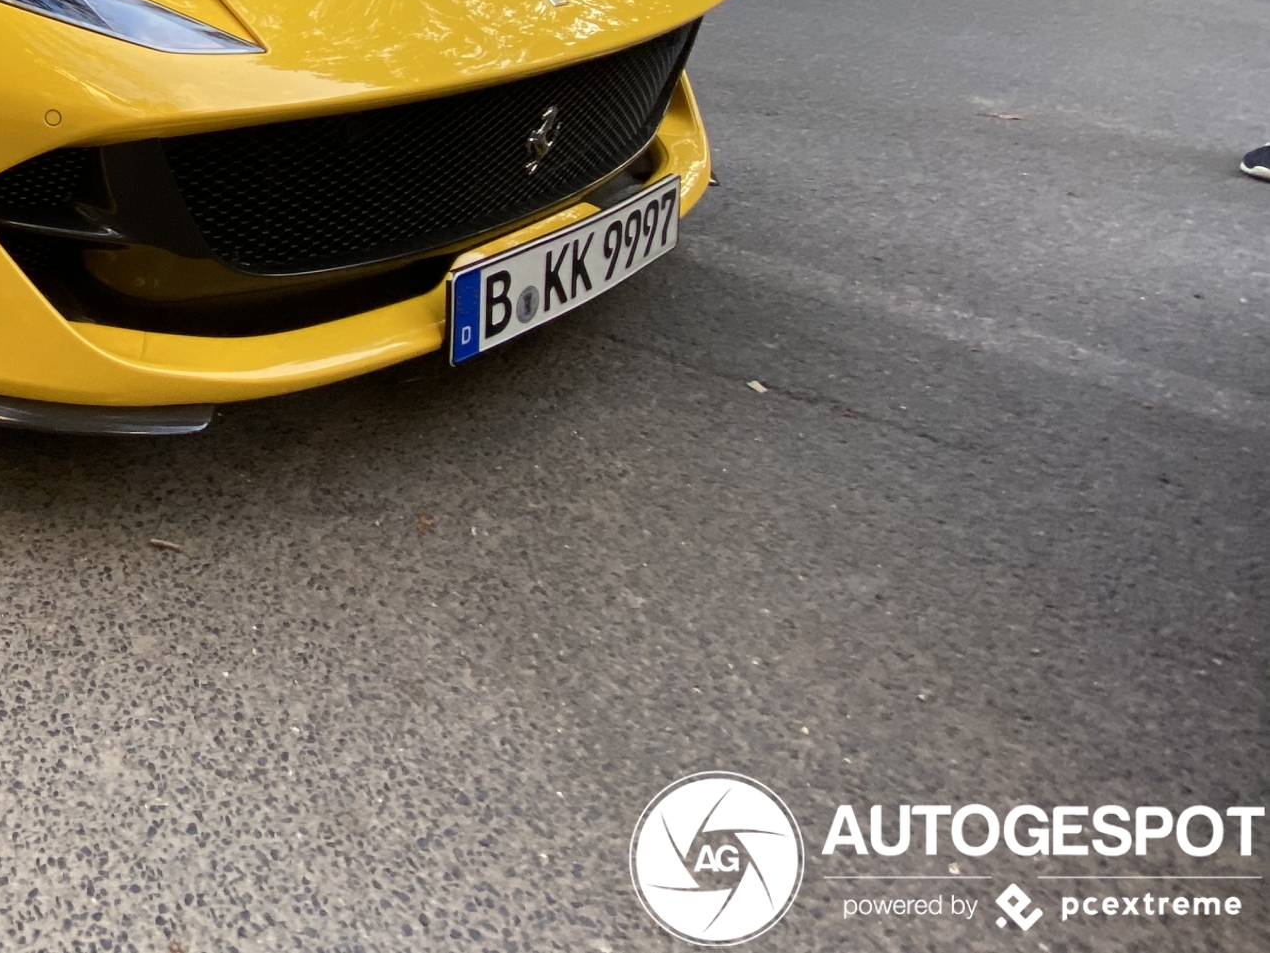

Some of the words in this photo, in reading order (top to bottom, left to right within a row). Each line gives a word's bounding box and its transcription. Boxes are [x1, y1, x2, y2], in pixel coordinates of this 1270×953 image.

[485, 270, 512, 339] B
[543, 232, 594, 312] KK
[603, 188, 677, 281] 9997
[461, 326, 472, 345] D
